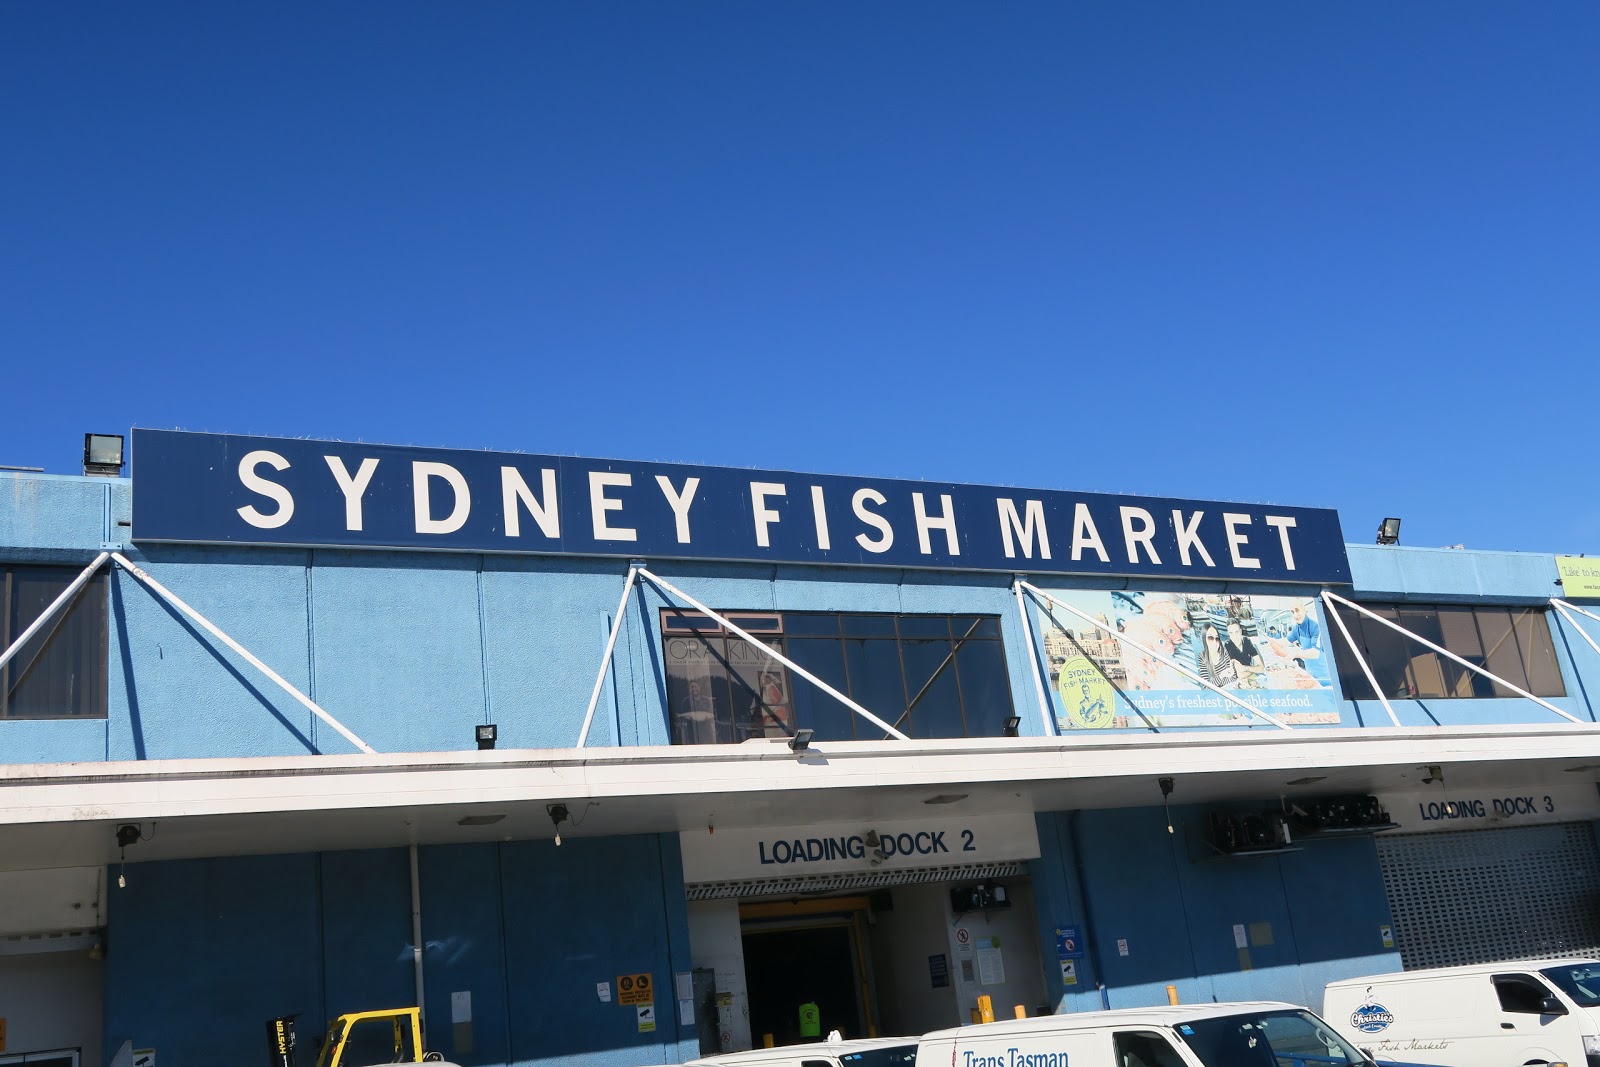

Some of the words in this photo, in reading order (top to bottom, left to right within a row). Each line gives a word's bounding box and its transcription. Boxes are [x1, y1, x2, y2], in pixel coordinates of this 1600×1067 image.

[236, 449, 701, 545] SYDNEY
[749, 481, 962, 558] FISH
[996, 497, 1299, 573] MARKET
[1063, 679, 1079, 690] FISH
[1078, 677, 1107, 686] MARKET
[1067, 668, 1096, 679] SYDNEY
[1176, 694, 1222, 709] freshest
[1224, 694, 1269, 712] poible
[1269, 693, 1313, 708] seafood.
[1419, 798, 1486, 821] LOADING
[1492, 796, 1538, 816] DOCK
[1543, 795, 1555, 813] 3
[758, 835, 865, 865] LOADING
[879, 831, 949, 857] DOCK
[960, 829, 976, 852] 2
[275, 1020, 287, 1055] HYSTER
[1378, 1038, 1401, 1052] Fish
[1404, 1038, 1455, 1051] Markets
[963, 1050, 1004, 1067] Trans
[1007, 1047, 1069, 1067] Tasman
